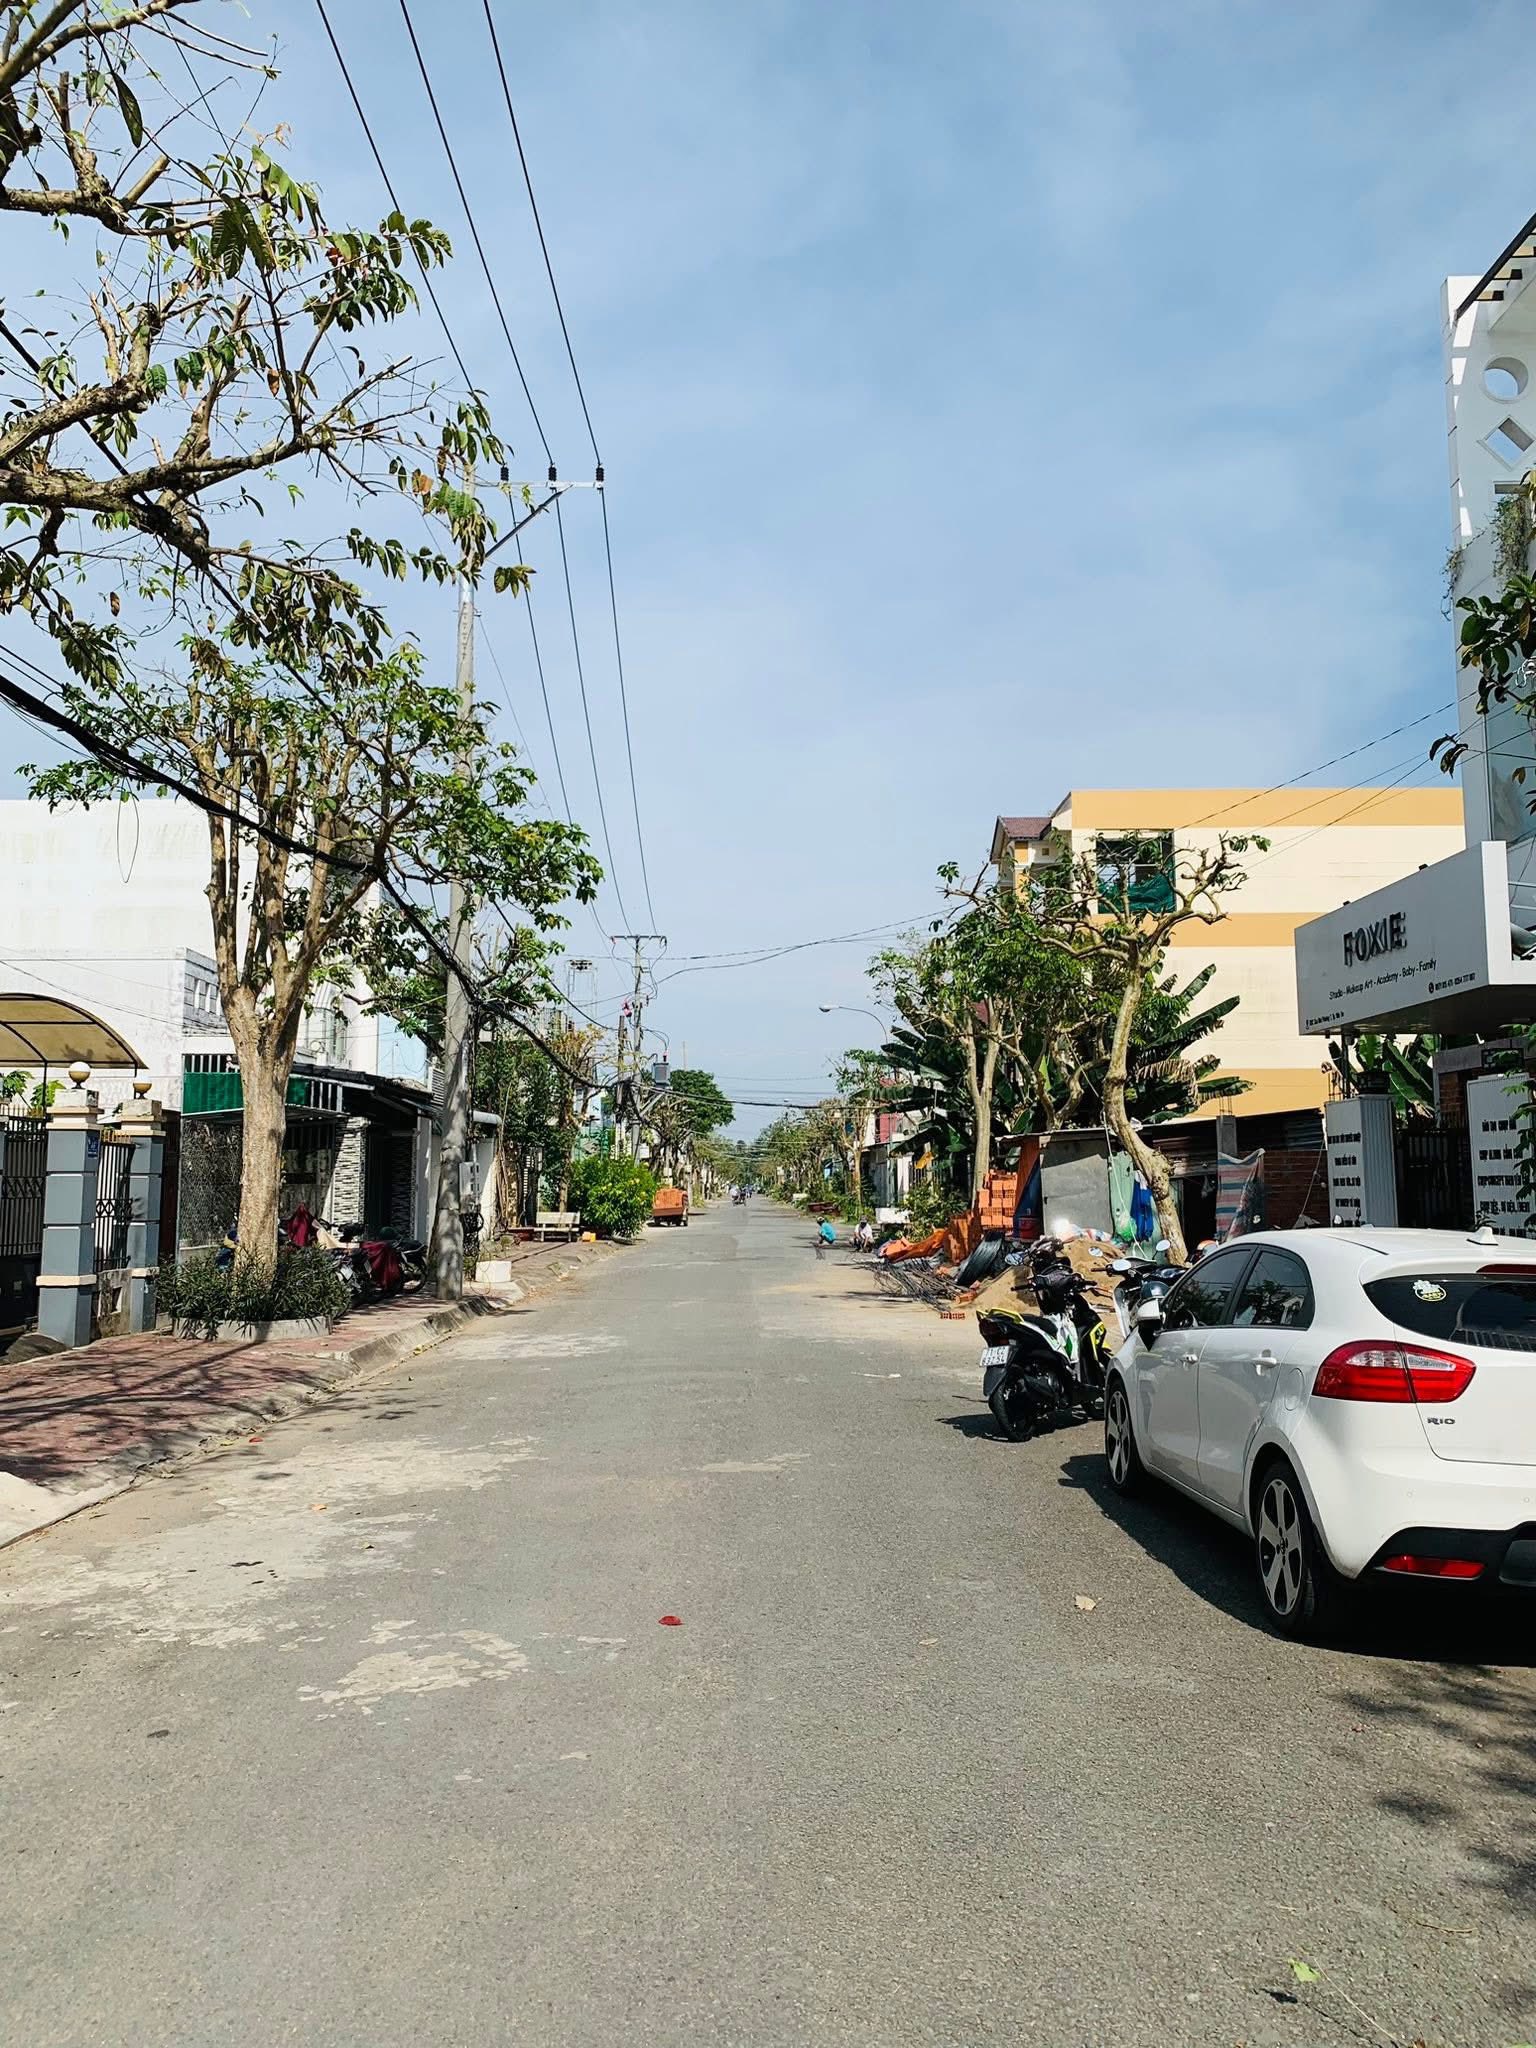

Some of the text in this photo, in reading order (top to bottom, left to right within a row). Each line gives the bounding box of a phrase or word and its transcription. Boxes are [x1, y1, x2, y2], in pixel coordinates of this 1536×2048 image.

[1343, 912, 1407, 967] FOXIE
[1364, 979, 1373, 989] Art
[1376, 972, 1398, 985] Academy
[1401, 966, 1415, 978] Baby
[1418, 958, 1437, 972] Family
[1427, 1417, 1456, 1425] RIO
